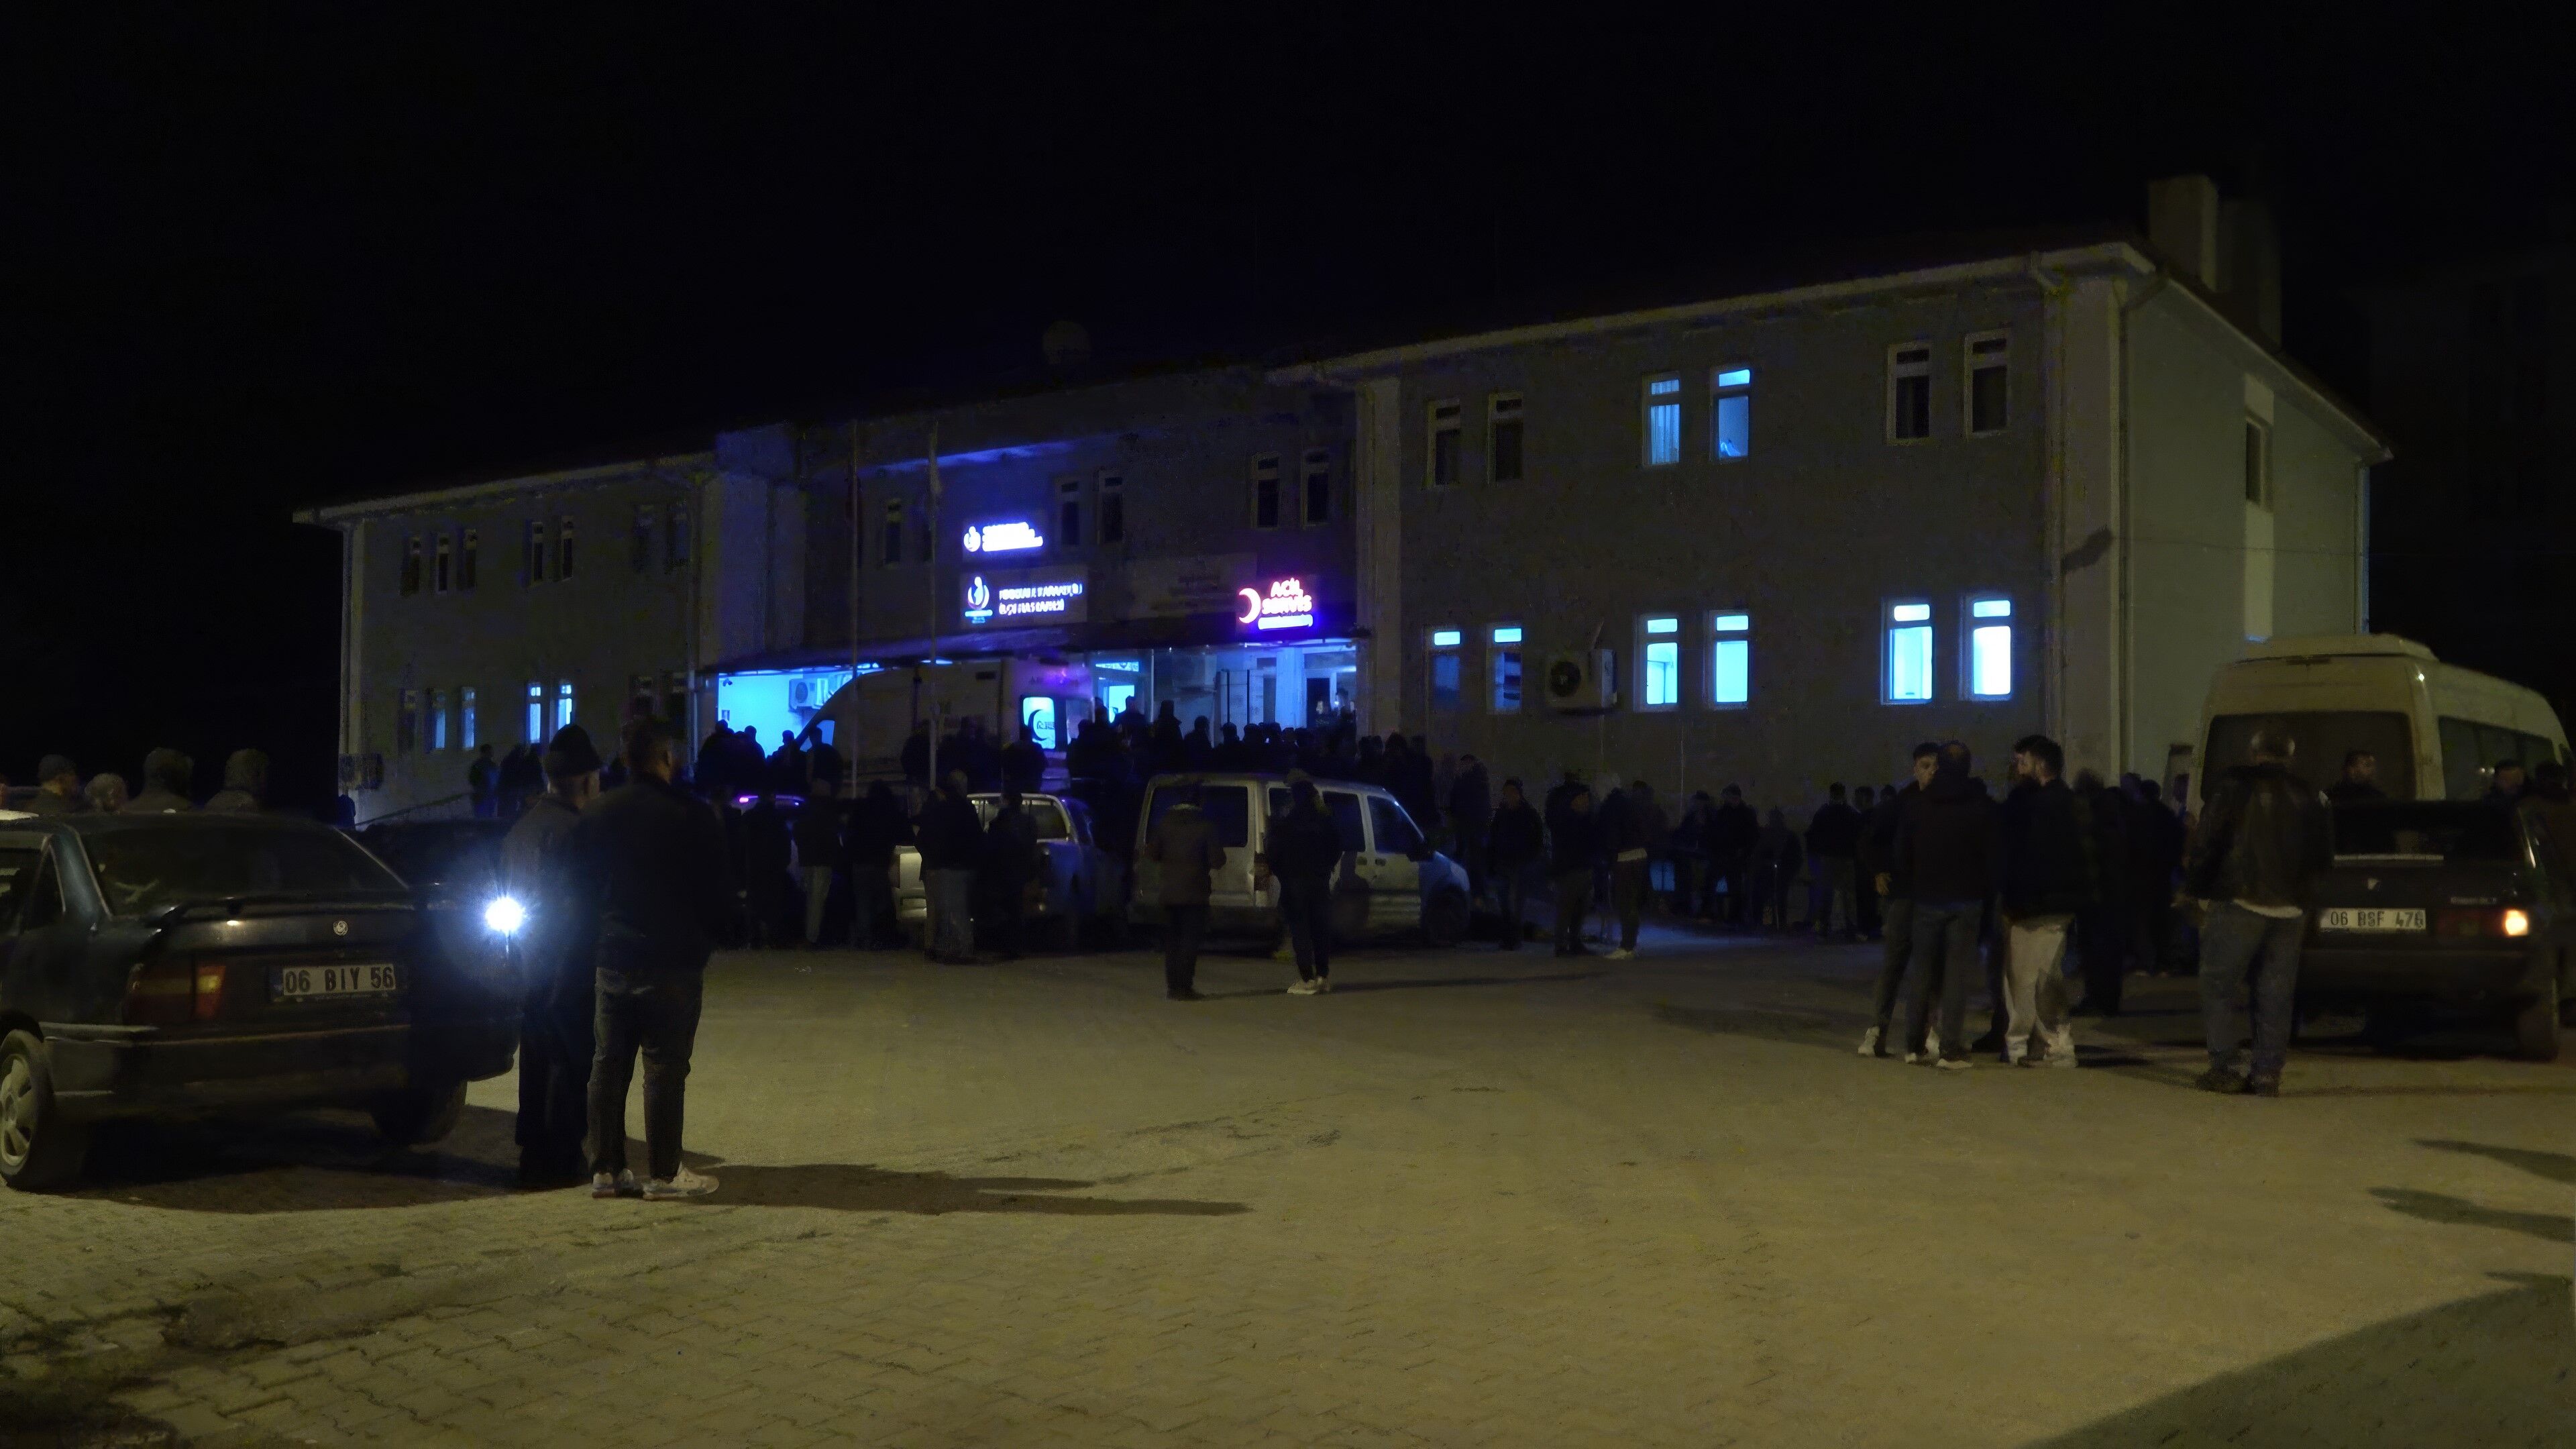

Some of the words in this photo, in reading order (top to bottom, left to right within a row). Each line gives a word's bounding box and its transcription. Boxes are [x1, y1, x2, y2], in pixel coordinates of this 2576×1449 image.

[2330, 911, 2349, 926] 06
[2357, 911, 2385, 927] BSF
[285, 970, 311, 994] 06
[325, 967, 360, 991] BIY
[370, 966, 394, 989] 56
